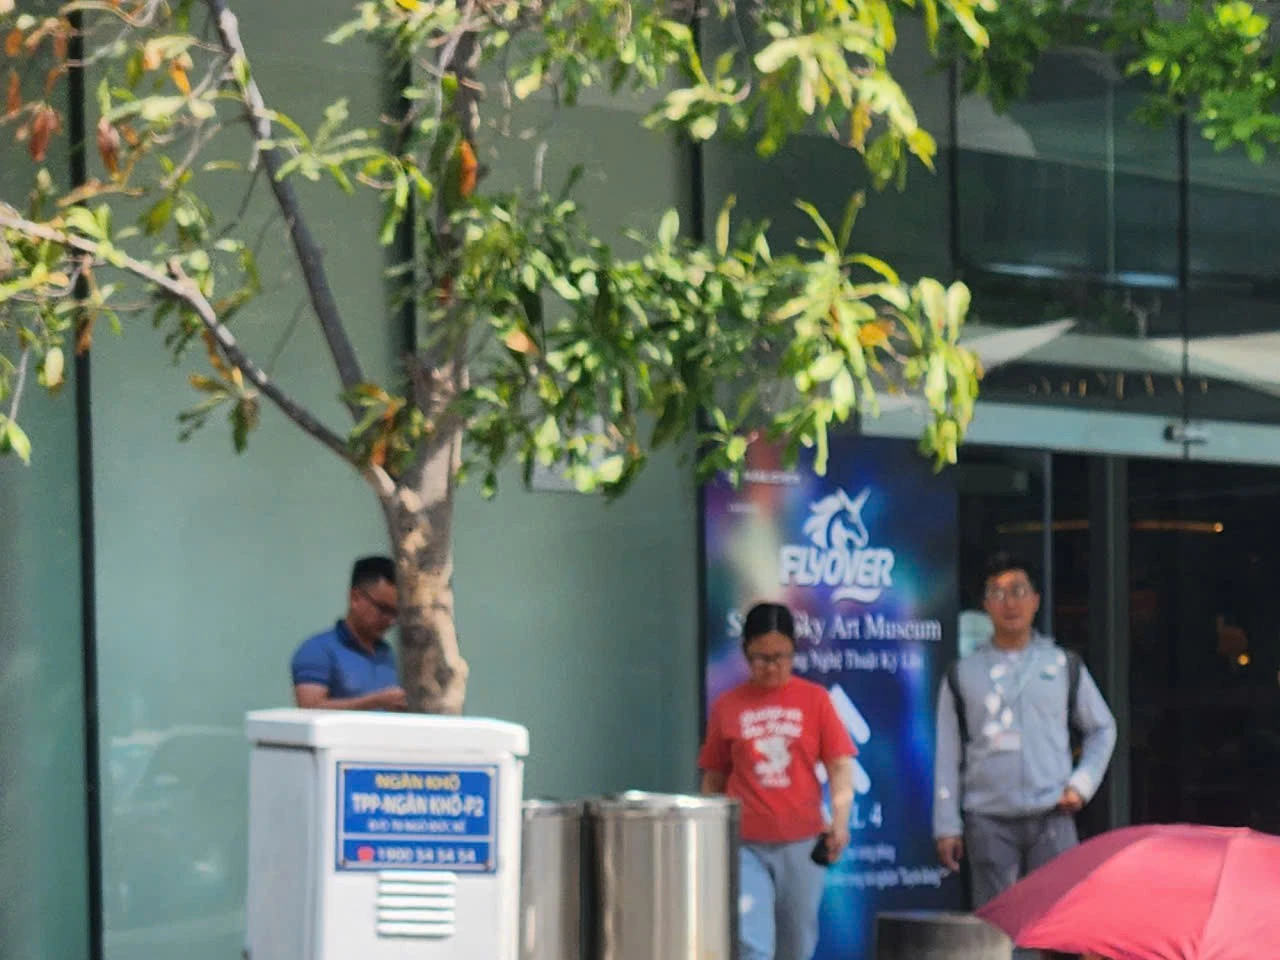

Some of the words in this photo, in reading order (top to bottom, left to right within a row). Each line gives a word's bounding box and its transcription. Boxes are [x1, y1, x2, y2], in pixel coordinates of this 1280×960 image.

[780, 545, 896, 586] FLYOVER
[831, 613, 860, 640] Art
[864, 613, 942, 641] Museum
